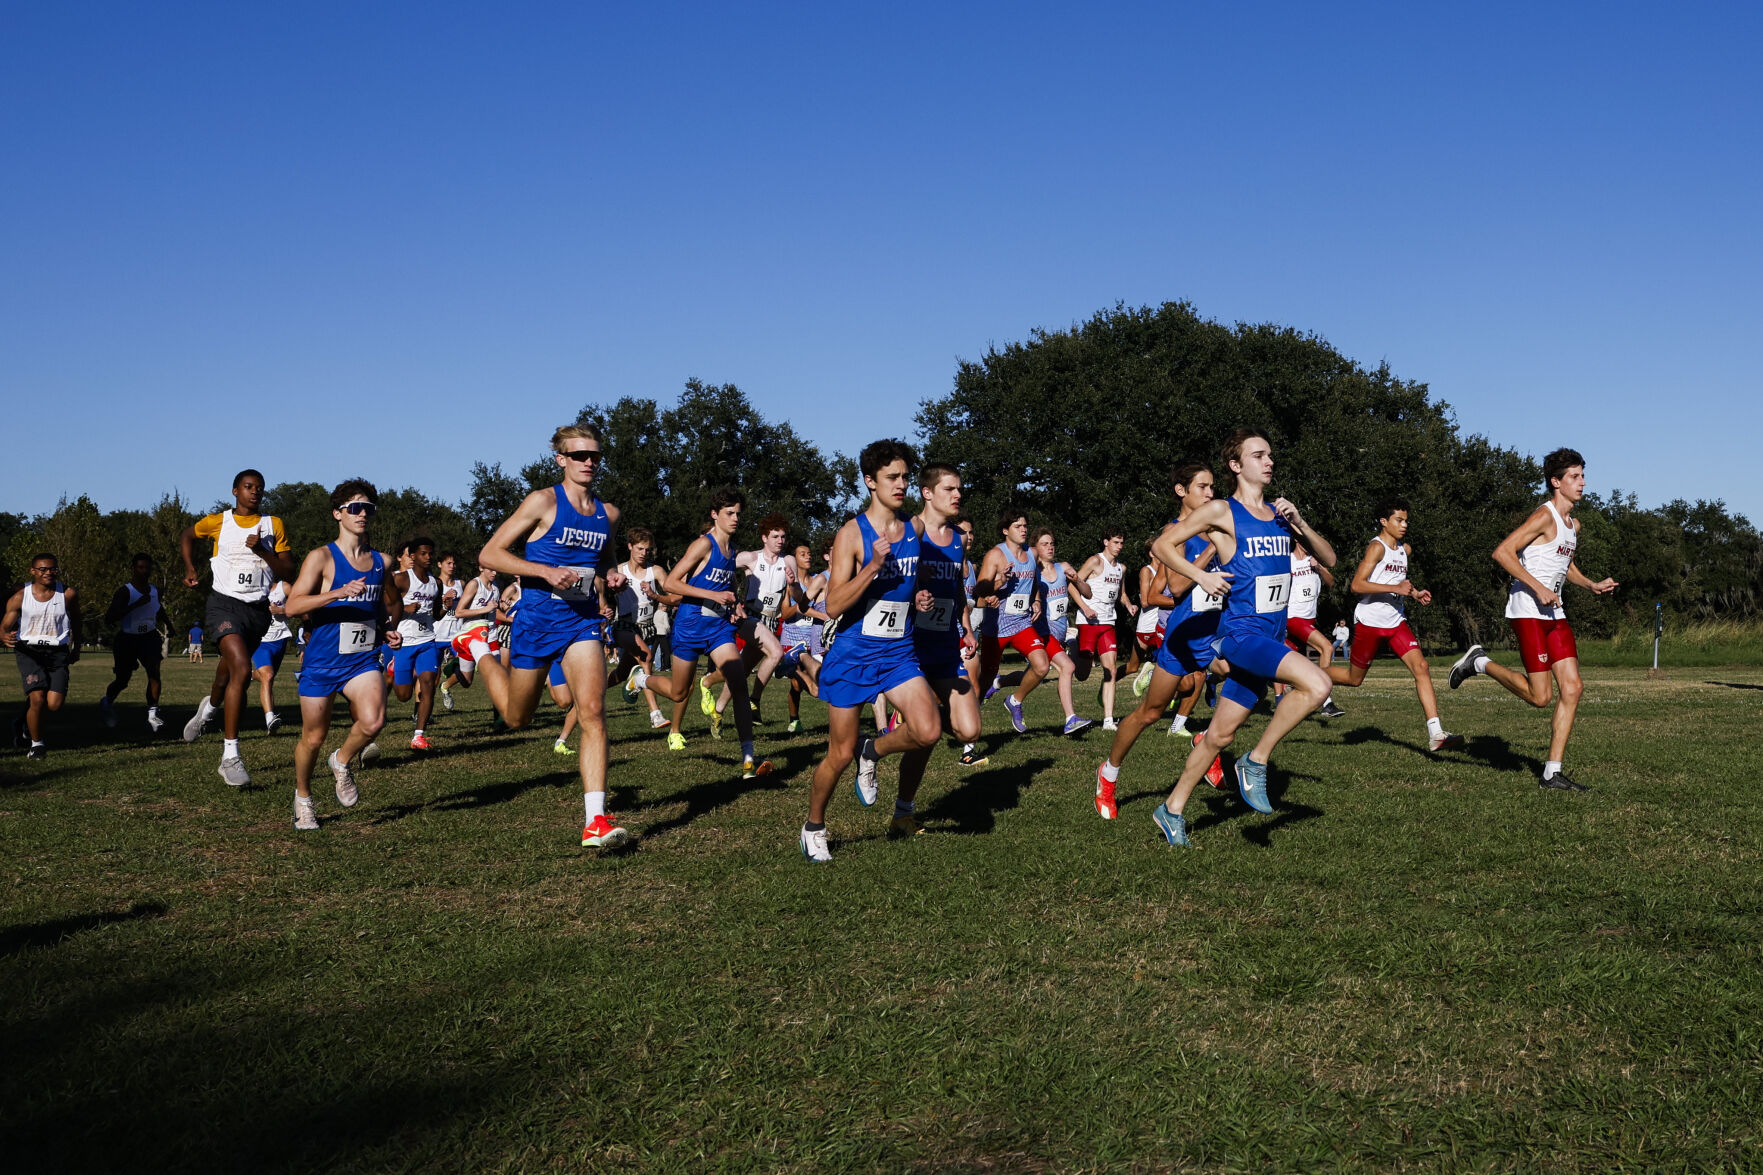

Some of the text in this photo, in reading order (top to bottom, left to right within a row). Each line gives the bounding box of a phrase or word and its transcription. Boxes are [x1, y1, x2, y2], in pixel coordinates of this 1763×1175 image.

[556, 526, 607, 551] JESUIT
[1243, 535, 1291, 558] JESUIT
[873, 556, 919, 580] ESUIT
[238, 572, 253, 585] 94
[1268, 584, 1283, 602] 77
[1302, 588, 1312, 597] 52
[762, 596, 774, 606] 68
[1013, 599, 1024, 609] 49
[1056, 603, 1065, 613] 45
[638, 606, 649, 617] 70
[878, 610, 897, 628] 76
[929, 607, 946, 622] 72
[351, 629, 367, 645] 73
